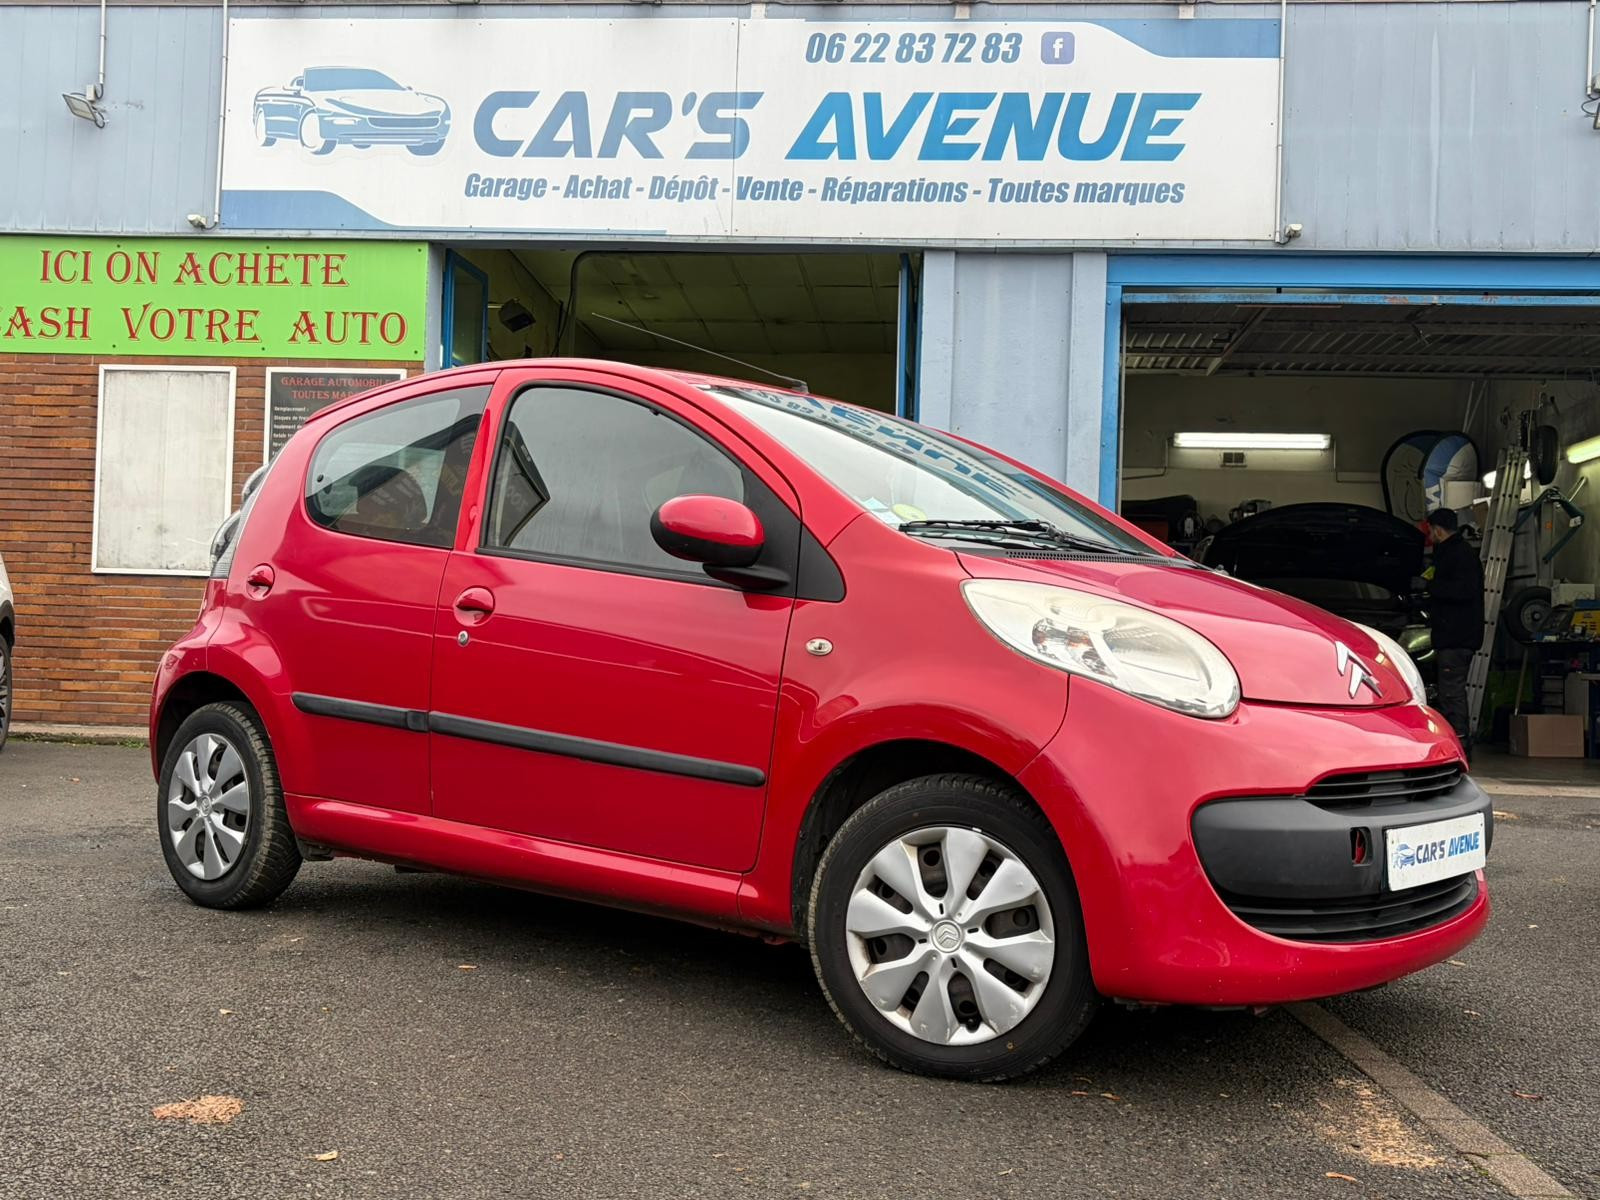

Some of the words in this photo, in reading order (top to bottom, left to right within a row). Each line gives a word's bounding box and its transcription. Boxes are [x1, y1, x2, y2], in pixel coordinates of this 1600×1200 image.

[805, 32, 847, 64] 06
[850, 32, 892, 64] 22
[895, 32, 937, 65] 83
[941, 32, 977, 65] 72
[980, 32, 1024, 65] 83
[473, 90, 765, 160] CAR'S
[784, 91, 1202, 163] AVENUE
[464, 173, 548, 201] Garage
[563, 174, 633, 200] Achat
[648, 174, 719, 203] Dépôt
[735, 175, 804, 202] Vente
[820, 176, 969, 205] Réparations
[988, 178, 1070, 204] Toutes
[1073, 181, 1186, 206] marques
[40, 250, 93, 284] ICI
[106, 250, 161, 285] ON
[174, 252, 350, 287] ACHETE
[0, 305, 92, 340] ASH
[121, 302, 261, 344] VOTRE
[288, 311, 408, 345] AUTO
[281, 377, 325, 387] GARAGE
[291, 390, 329, 400] TOUTES
[1416, 839, 1446, 864] CAR'S
[1447, 831, 1480, 858] AVENUE
